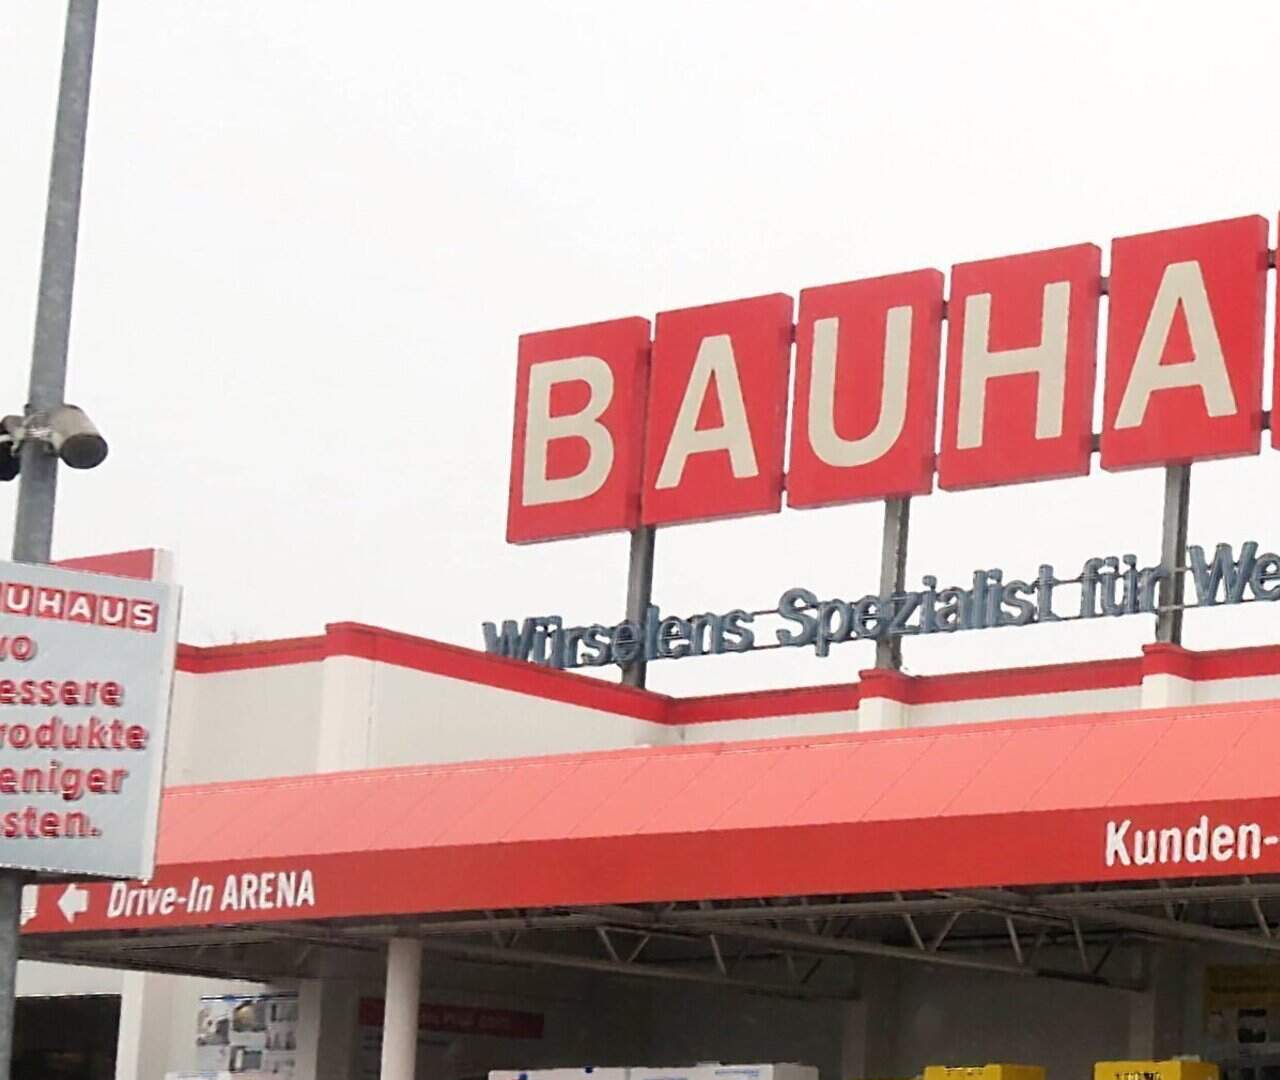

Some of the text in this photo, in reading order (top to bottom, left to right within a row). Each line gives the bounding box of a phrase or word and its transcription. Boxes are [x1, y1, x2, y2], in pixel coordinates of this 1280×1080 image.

[5, 585, 153, 626] UHAUS
[481, 603, 755, 669] Würselens
[777, 564, 1063, 657] Spezialist
[1077, 553, 1168, 618] für
[0, 679, 123, 705] essere
[0, 761, 128, 800] eniger
[3, 806, 101, 838] sten.
[107, 869, 315, 917] Drive-In ARENA
